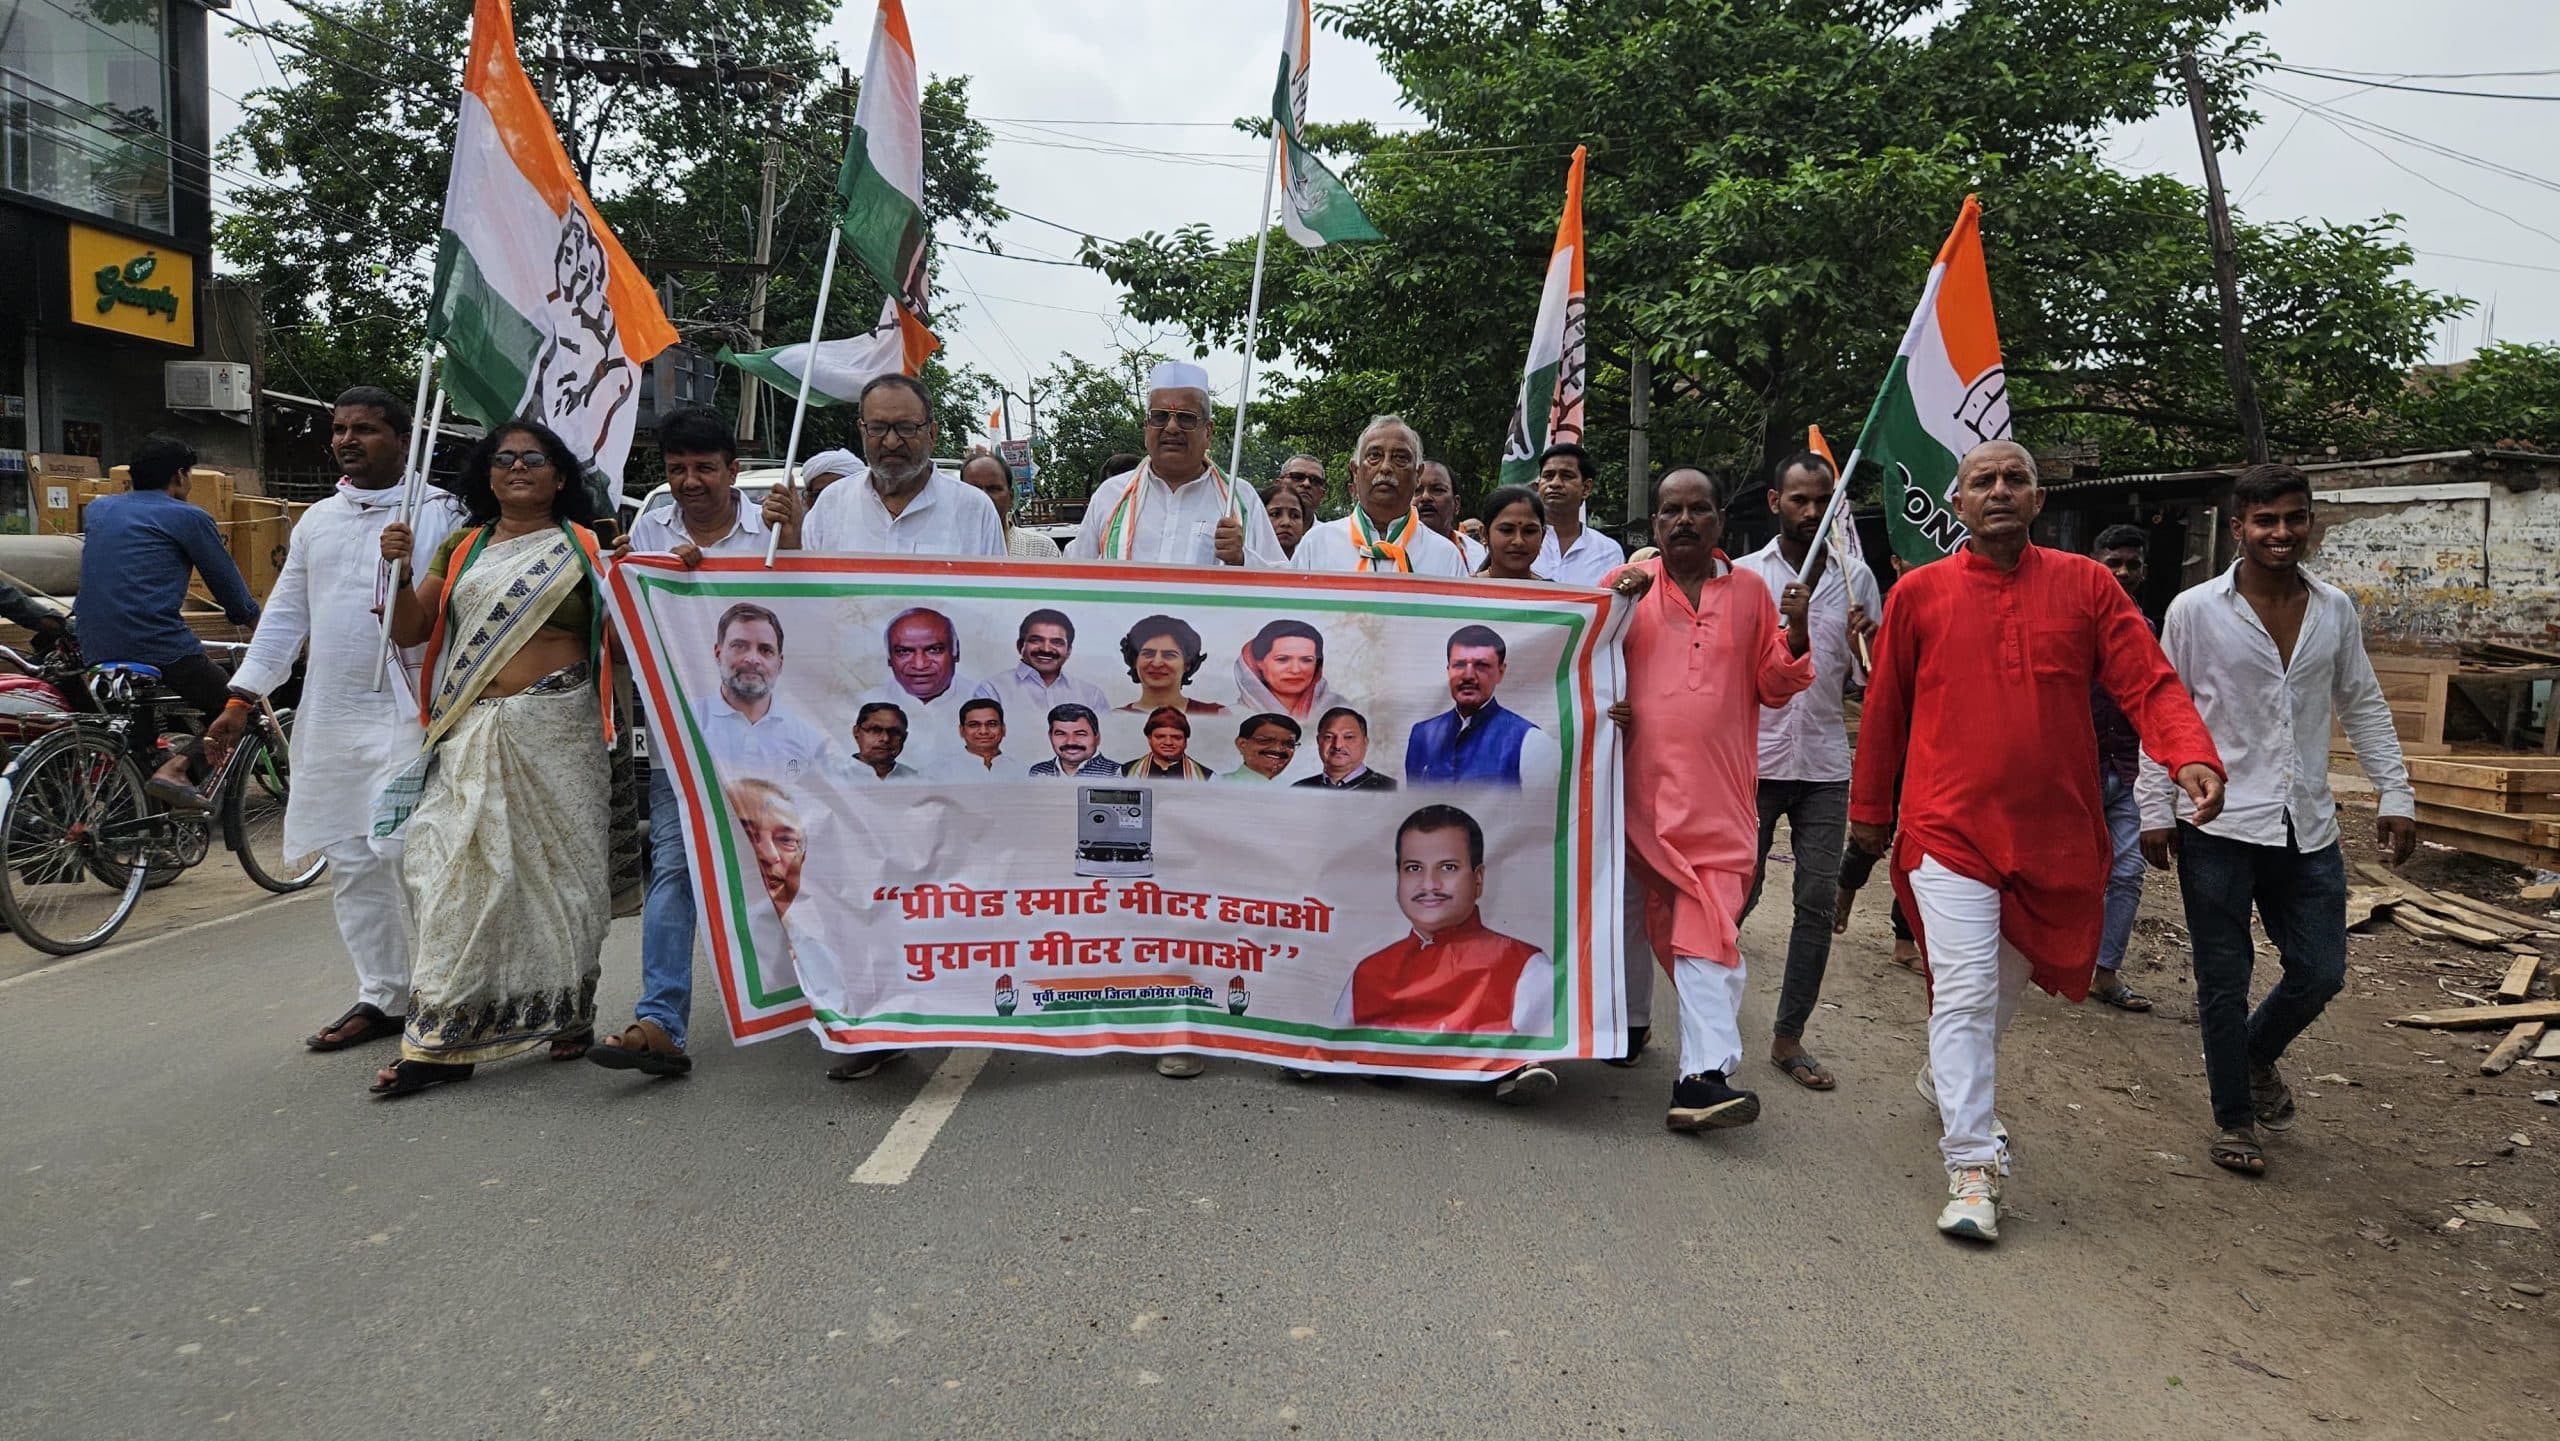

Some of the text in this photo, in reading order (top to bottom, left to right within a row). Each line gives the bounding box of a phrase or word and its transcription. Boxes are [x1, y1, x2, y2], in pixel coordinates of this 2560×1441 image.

[1015, 879, 1110, 915] स्मार्ट
[1118, 881, 1211, 919] मीटर
[1218, 896, 1334, 932] हटाओ
[904, 941, 1019, 981] पुराना
[1028, 931, 1125, 965] मीटर
[1032, 984, 1213, 1006] पूर्वी चम्पारण जिला कांग्रेस कमिटी
